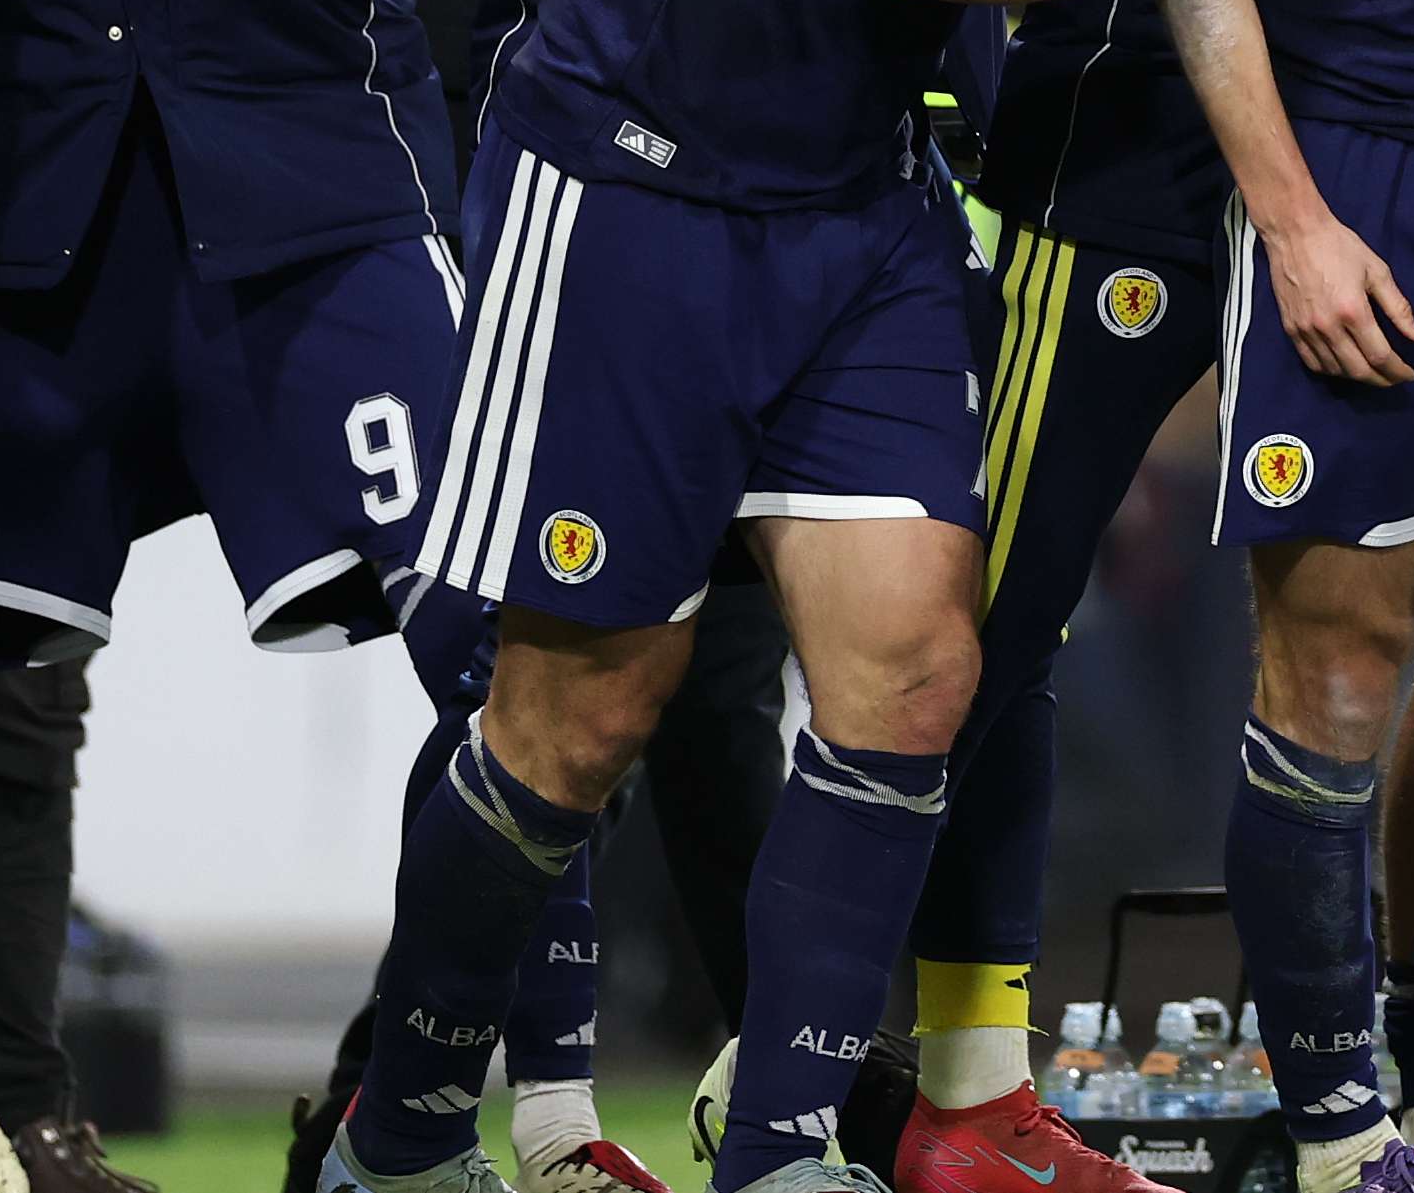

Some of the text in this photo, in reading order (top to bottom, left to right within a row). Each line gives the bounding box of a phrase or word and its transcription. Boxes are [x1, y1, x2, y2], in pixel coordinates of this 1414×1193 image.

[344, 391, 422, 525] 9
[1263, 435, 1299, 445] SCOTLAND
[548, 940, 600, 964] AL
[406, 1008, 496, 1046] ALBA
[790, 1025, 871, 1063] ALBA
[1290, 1029, 1372, 1053] ALBA
[1114, 1134, 1214, 1176] Squash
